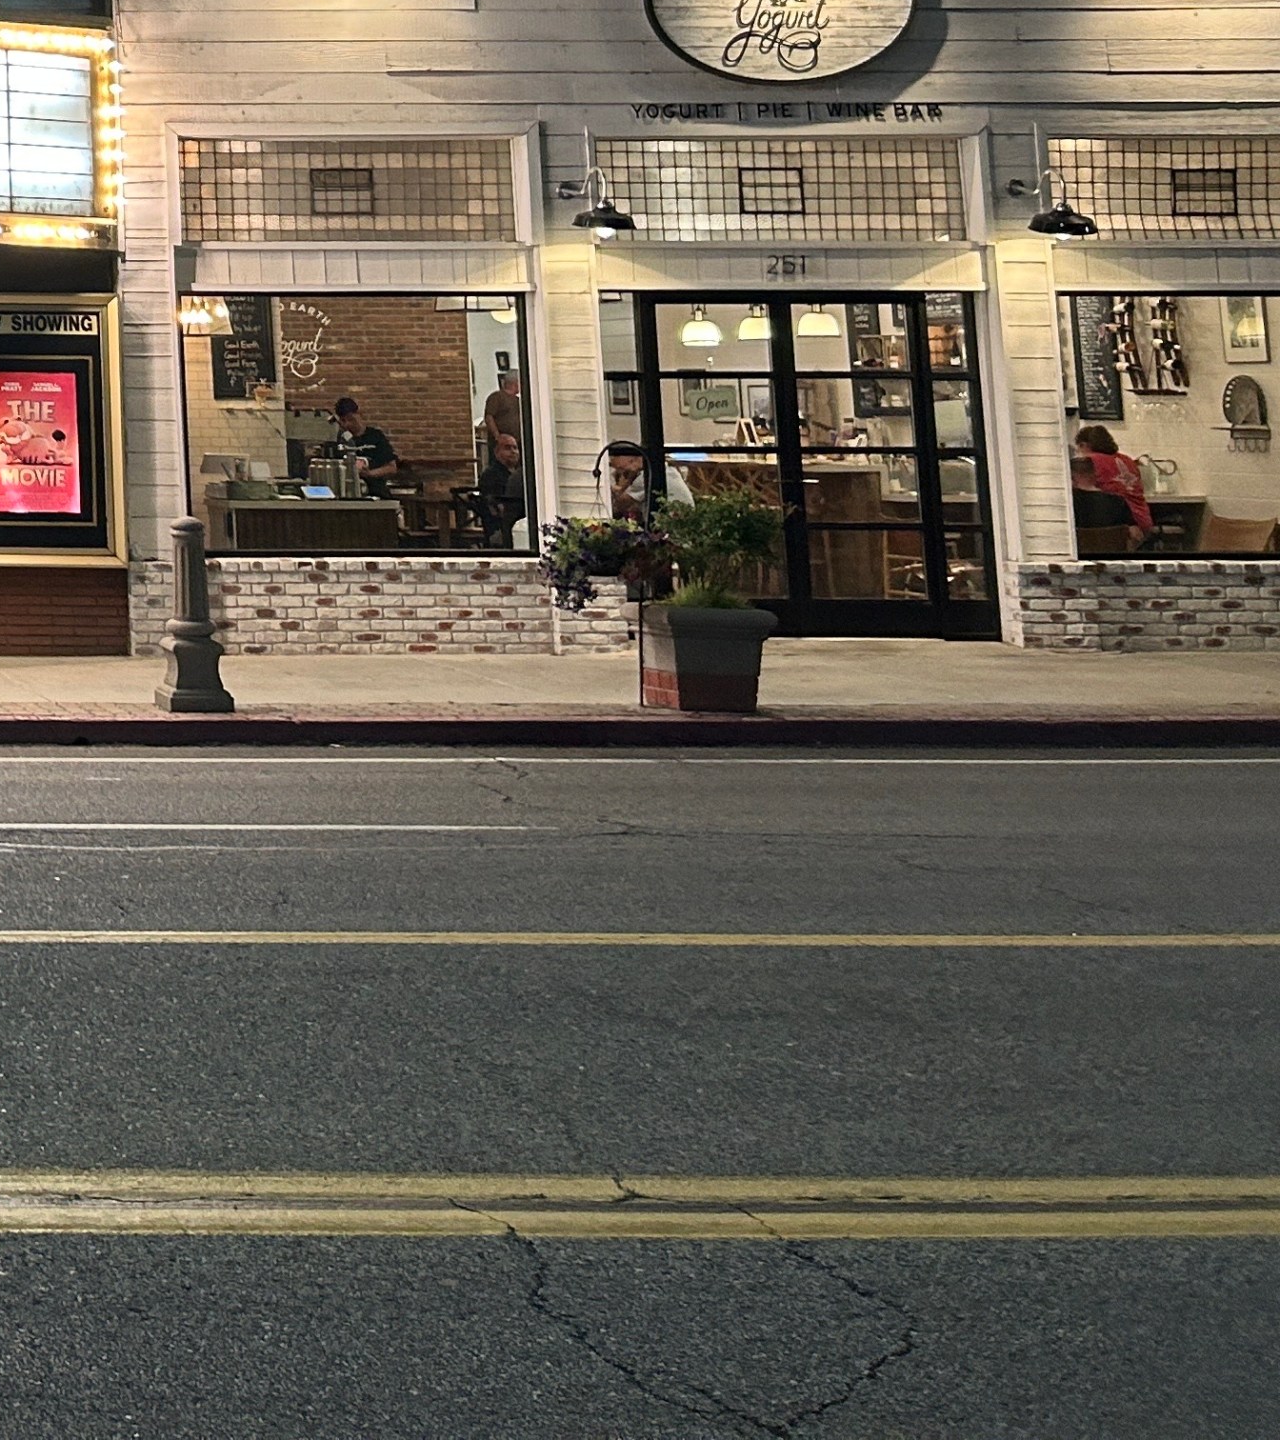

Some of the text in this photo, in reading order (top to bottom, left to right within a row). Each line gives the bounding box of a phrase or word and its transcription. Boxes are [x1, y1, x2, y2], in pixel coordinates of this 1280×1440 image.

[630, 102, 723, 119] YOGURT
[757, 102, 795, 119] PIE
[826, 102, 885, 119] WINE
[893, 102, 944, 120] BAR
[767, 255, 806, 275] 251
[11, 313, 93, 332] SHOWING
[289, 301, 332, 326] EARTH
[6, 401, 55, 423] THE
[696, 396, 729, 413] Open
[0, 468, 67, 487] MOVIE
